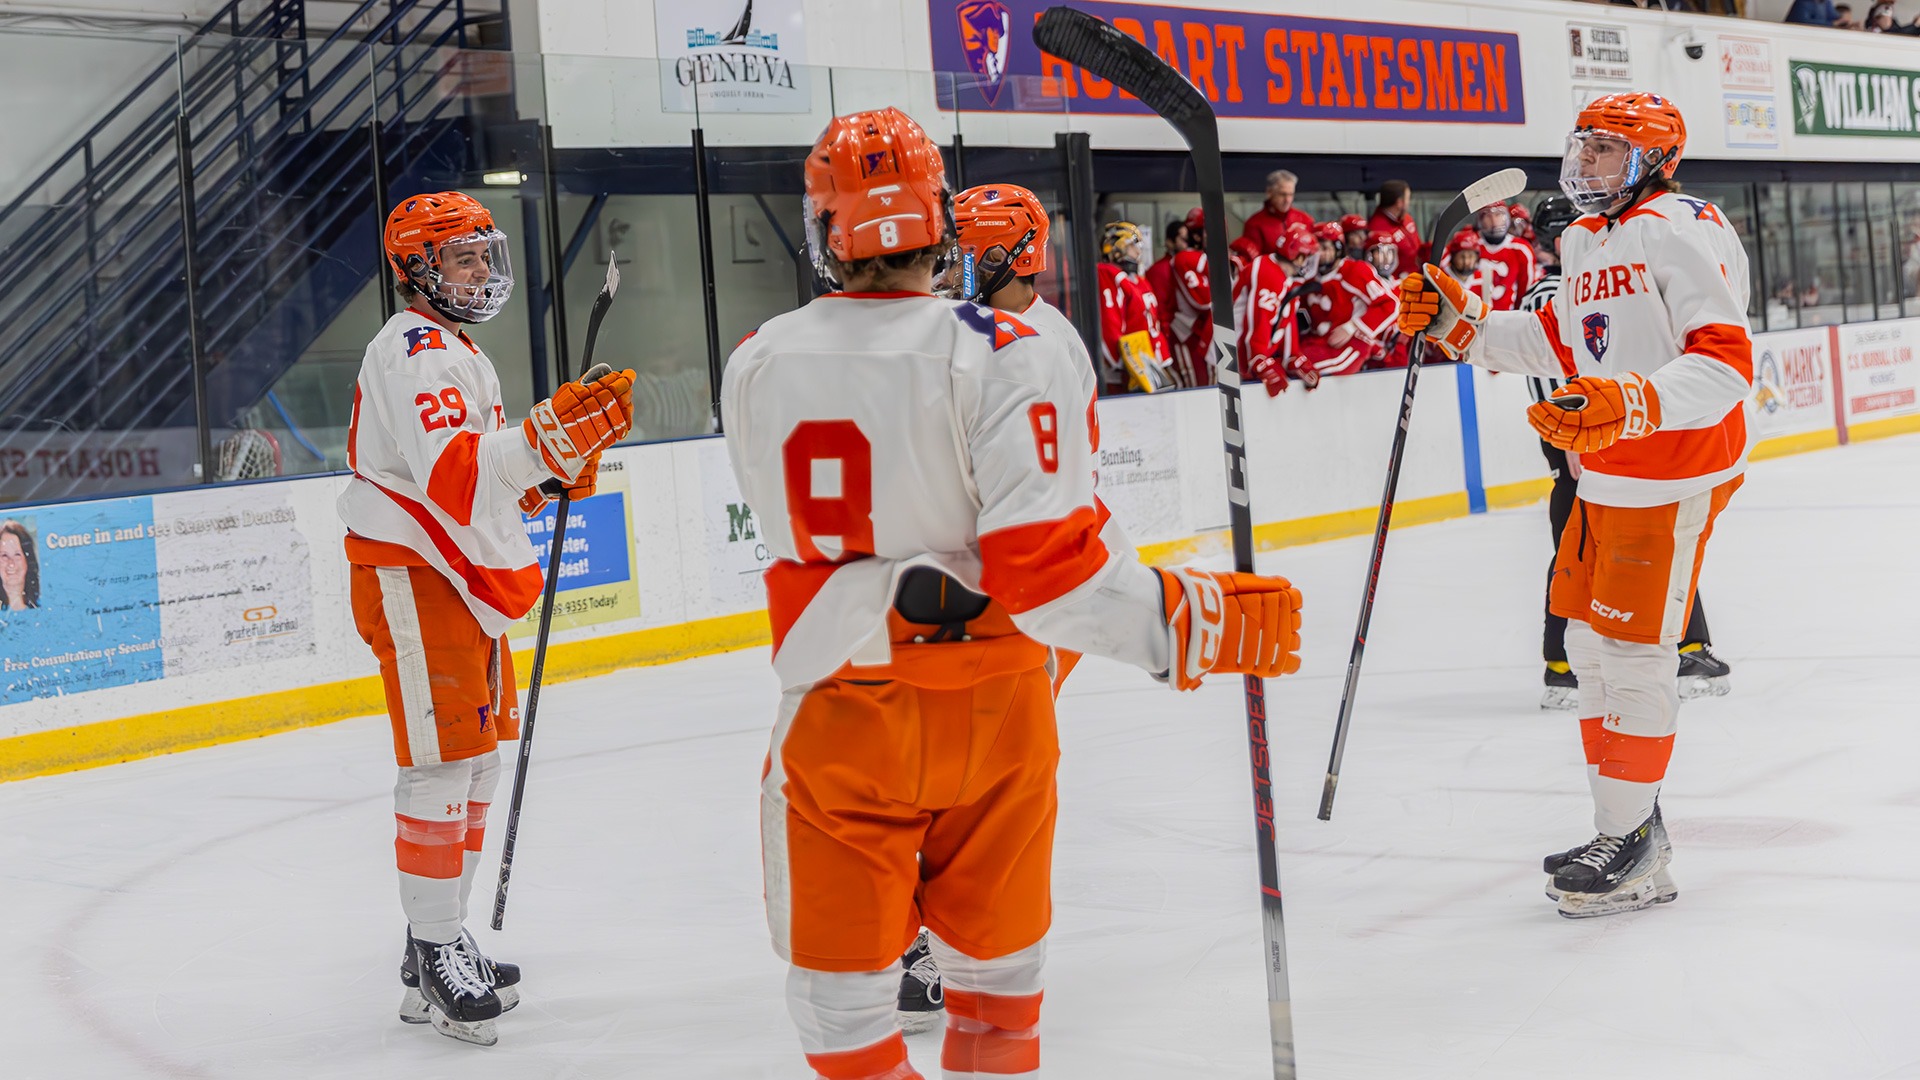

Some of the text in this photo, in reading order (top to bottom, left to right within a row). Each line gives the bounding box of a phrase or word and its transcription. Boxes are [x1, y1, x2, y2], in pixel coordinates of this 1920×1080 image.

[675, 53, 796, 90] GENEVA
[1264, 28, 1508, 112] STATESMEN
[879, 220, 898, 248] 8
[1568, 263, 1649, 306] OBART
[415, 387, 467, 433] 29
[1213, 323, 1250, 507] CCM
[1027, 401, 1059, 474] 8
[781, 418, 875, 564] 8
[46, 533, 91, 549] Come
[95, 528, 111, 544] in
[115, 524, 143, 542] and
[147, 523, 169, 538] see
[589, 593, 618, 608] Today!
[1590, 598, 1634, 623] CCM
[31, 650, 102, 668] Consultation
[103, 646, 116, 657] or
[118, 639, 155, 654] Second
[1244, 674, 1275, 842] JETSPEE
